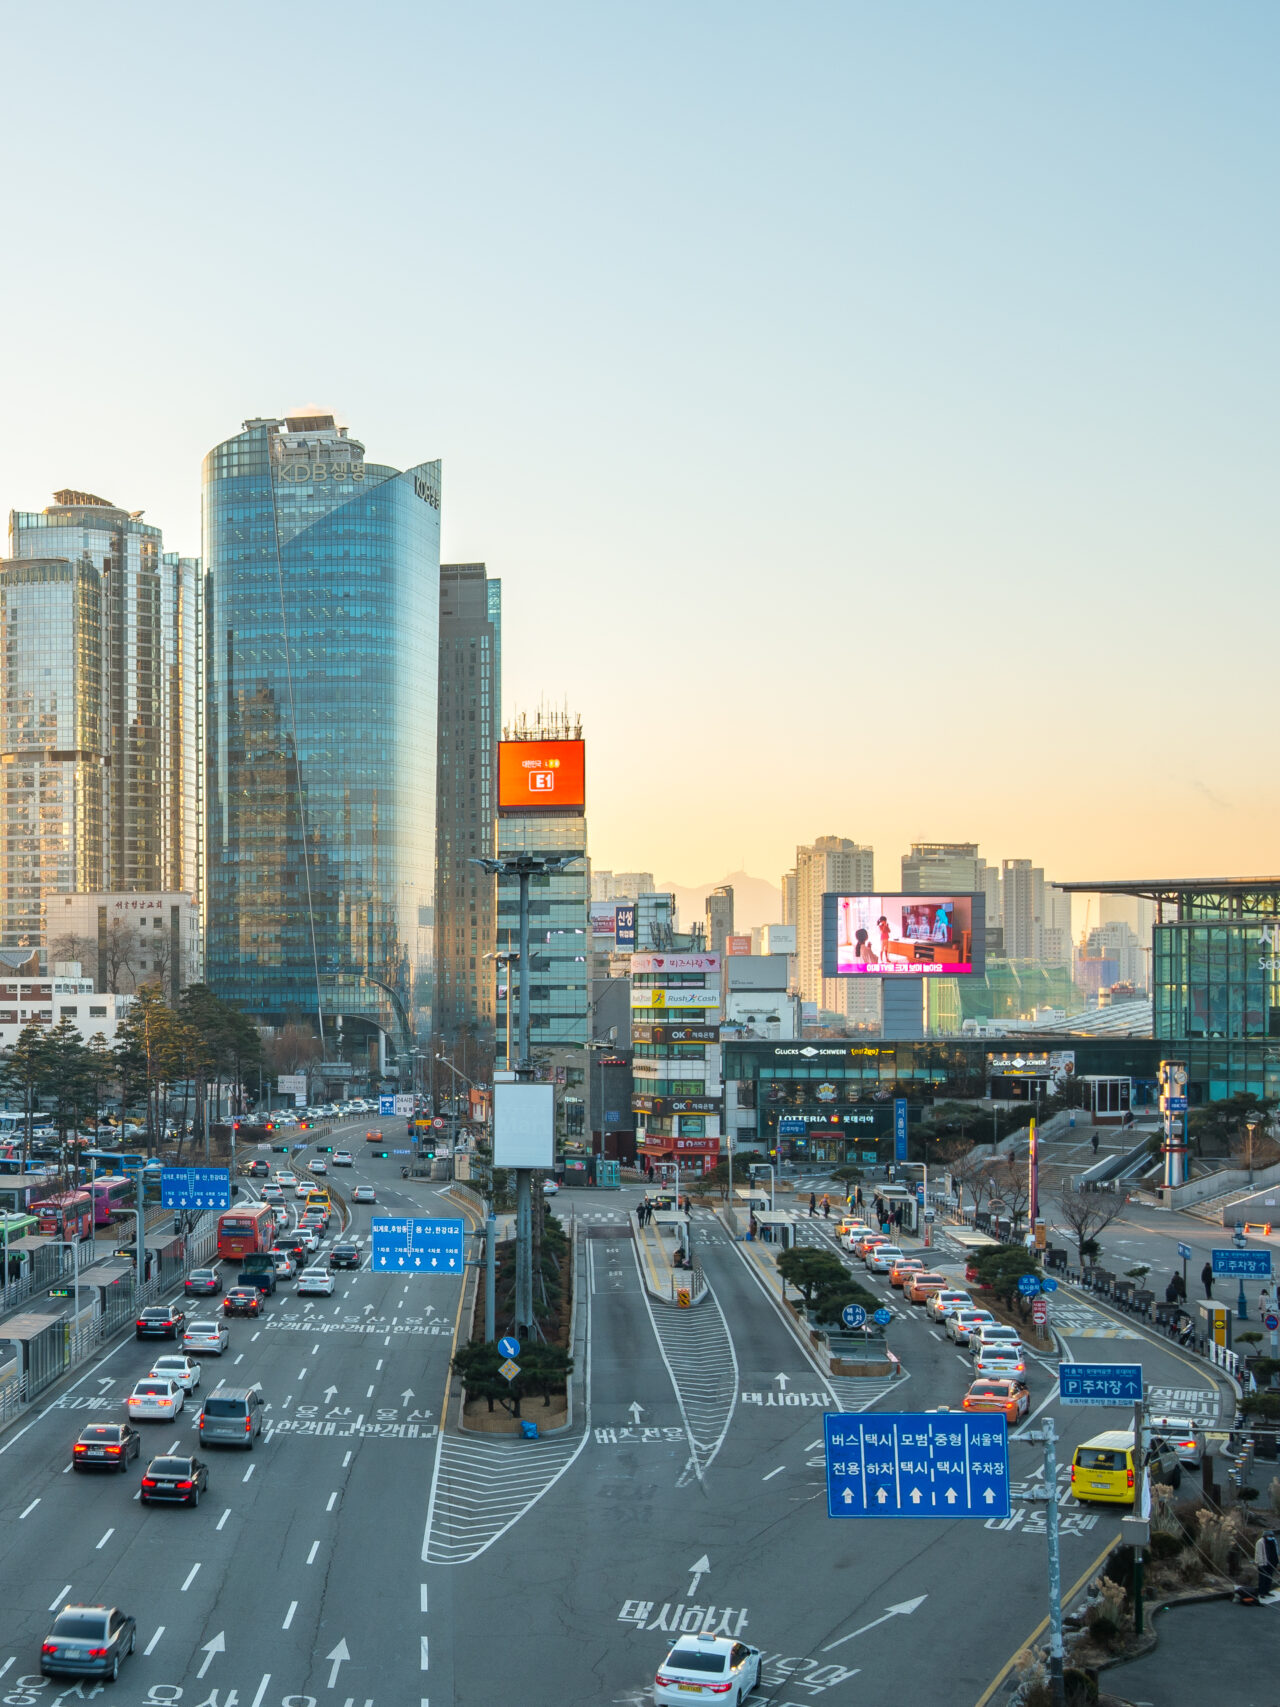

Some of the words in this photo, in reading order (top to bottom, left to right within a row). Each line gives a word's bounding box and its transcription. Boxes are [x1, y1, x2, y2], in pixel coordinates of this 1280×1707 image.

[277, 462, 366, 482] KDB생명
[536, 774, 551, 788] E1
[1218, 1261, 1225, 1270] P
[1228, 1260, 1257, 1271] 주차장
[1068, 1381, 1078, 1393] P
[1083, 1380, 1121, 1395] 주차장
[741, 1392, 832, 1407] 택시하차
[275, 1420, 357, 1437] 한강대교
[594, 1426, 688, 1445] 버스전용
[831, 1434, 859, 1447] 버스
[864, 1433, 892, 1447] 택시
[900, 1434, 928, 1447] 모범
[934, 1433, 962, 1447] 중형
[970, 1433, 1003, 1447] 서울역
[832, 1462, 860, 1476] 전용
[866, 1462, 894, 1476] 하차
[900, 1461, 928, 1475] 택시
[936, 1461, 964, 1475] 택시
[971, 1462, 1004, 1476] 주차장
[617, 1600, 749, 1637] 택시하차
